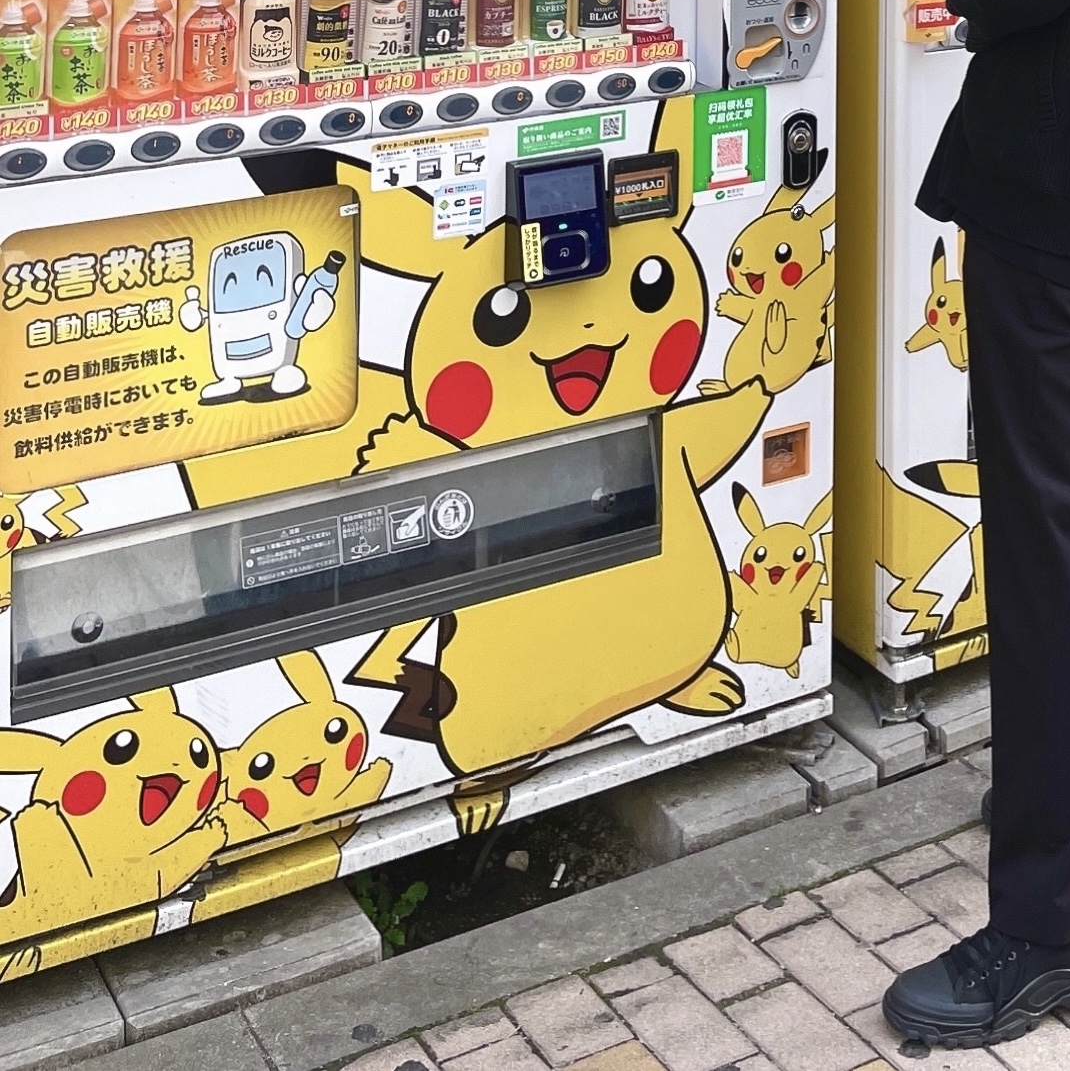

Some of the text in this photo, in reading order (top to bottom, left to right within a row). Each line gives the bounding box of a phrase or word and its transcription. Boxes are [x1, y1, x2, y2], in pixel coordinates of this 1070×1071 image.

[590, 10, 618, 21] BLACK
[252, 46, 291, 58] ミルクコーヒー
[321, 47, 340, 62] 90
[378, 40, 397, 55] 20
[590, 47, 628, 65] ¥150
[641, 41, 678, 59] ¥140
[485, 60, 524, 79] ¥130
[539, 54, 577, 71] ¥130
[1, 64, 27, 104] お茶
[69, 55, 95, 95] お茶
[376, 72, 417, 93] ¥110
[432, 66, 471, 85] ¥110
[255, 87, 298, 107] ¥130
[315, 78, 357, 100] ¥110
[127, 101, 174, 122] ¥140
[191, 93, 238, 115] ¥140
[61, 108, 110, 132] ¥140
[223, 237, 275, 260] Rescue
[2, 236, 193, 312] 災害救援
[26, 298, 173, 348] 自動販売機
[23, 345, 186, 389] この自動販売機は、
[3, 373, 198, 428] 災害停電時においても
[14, 409, 194, 459] 飲料供給ができます。
